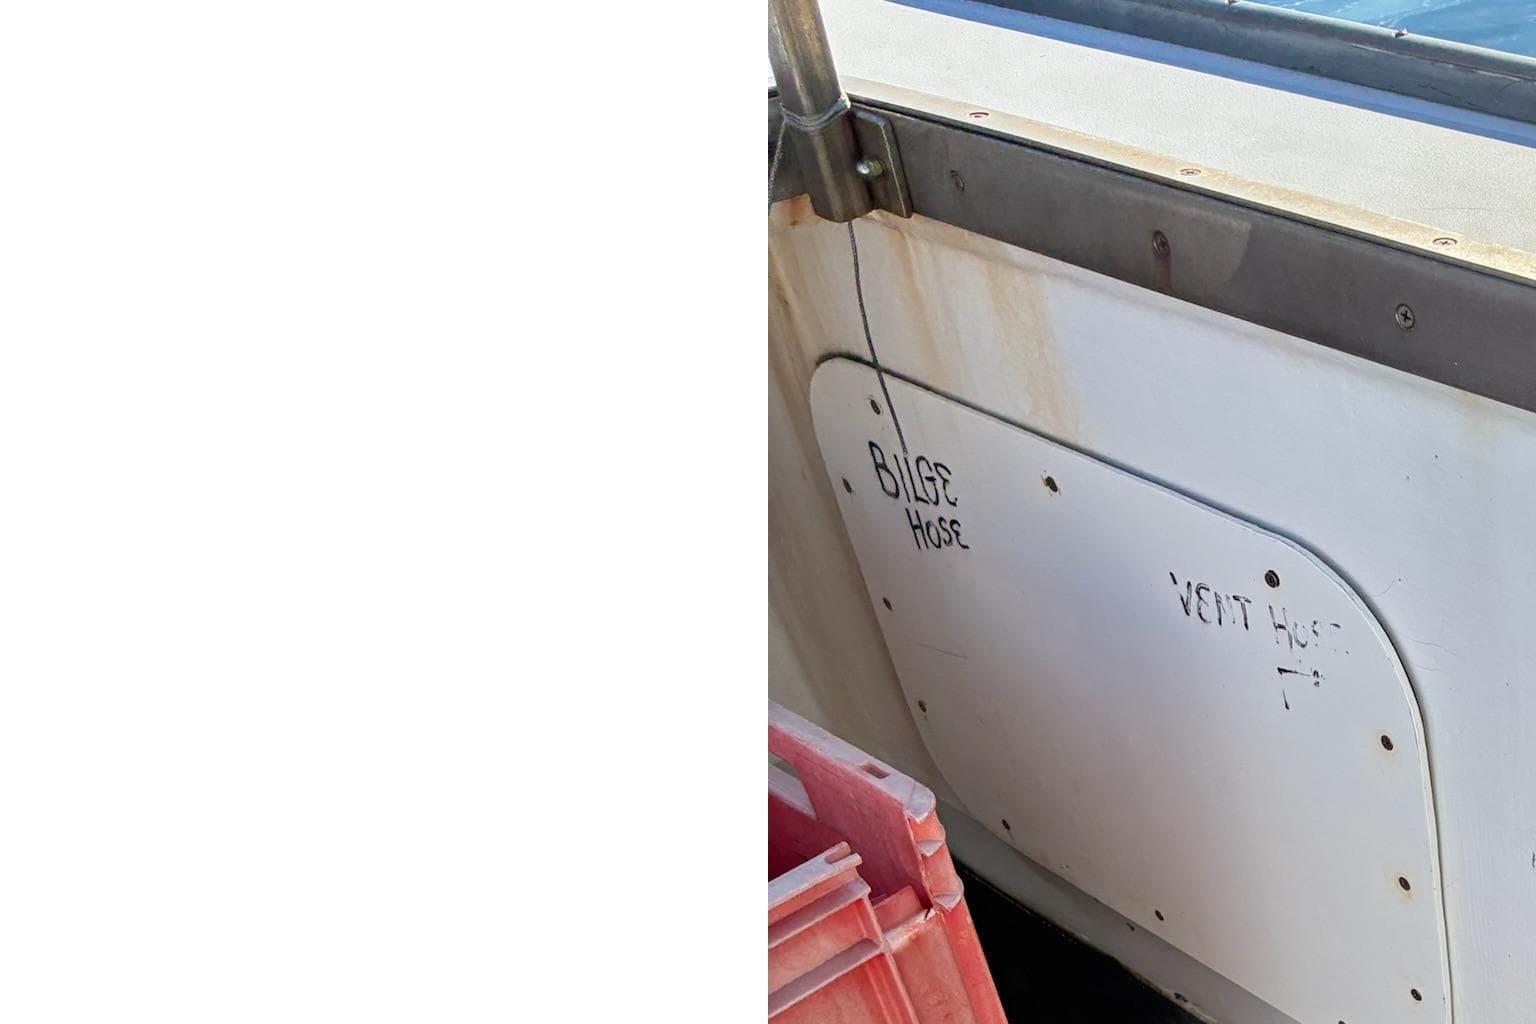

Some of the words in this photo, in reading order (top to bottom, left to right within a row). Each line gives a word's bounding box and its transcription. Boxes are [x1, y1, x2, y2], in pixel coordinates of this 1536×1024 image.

[867, 440, 958, 507] BILGE
[905, 507, 970, 550] HOSE
[1168, 571, 1252, 631] VENT
